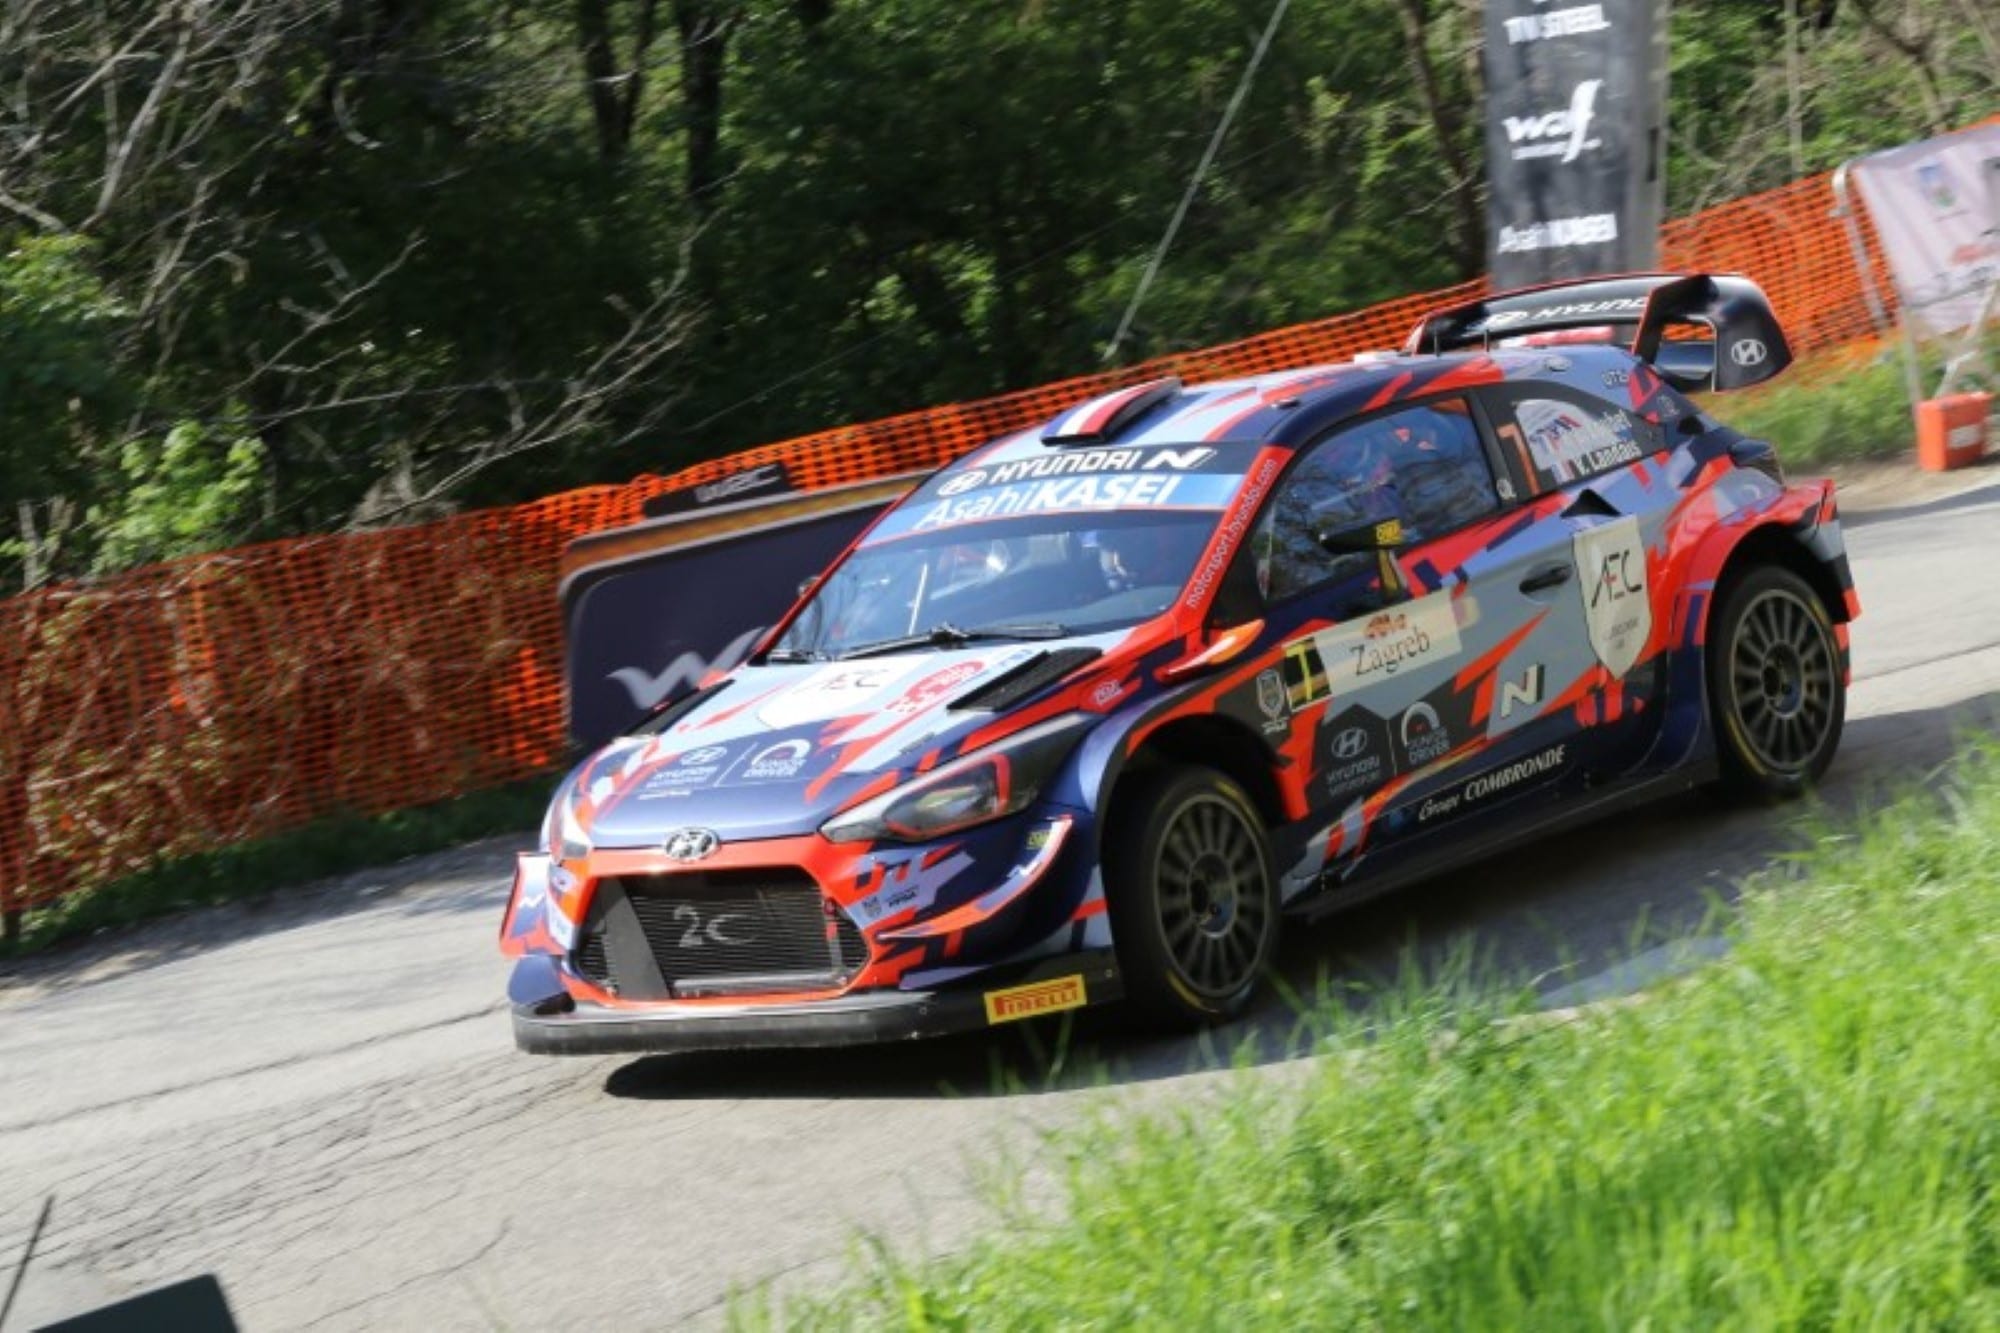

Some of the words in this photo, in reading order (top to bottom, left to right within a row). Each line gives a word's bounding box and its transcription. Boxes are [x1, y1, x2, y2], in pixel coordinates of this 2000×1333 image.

[989, 450, 1142, 484] HYUNDAI
[1351, 625, 1431, 677] Zagreb
[1465, 744, 1565, 801] COMBRONDE
[993, 980, 1078, 1018] PIRELLI
